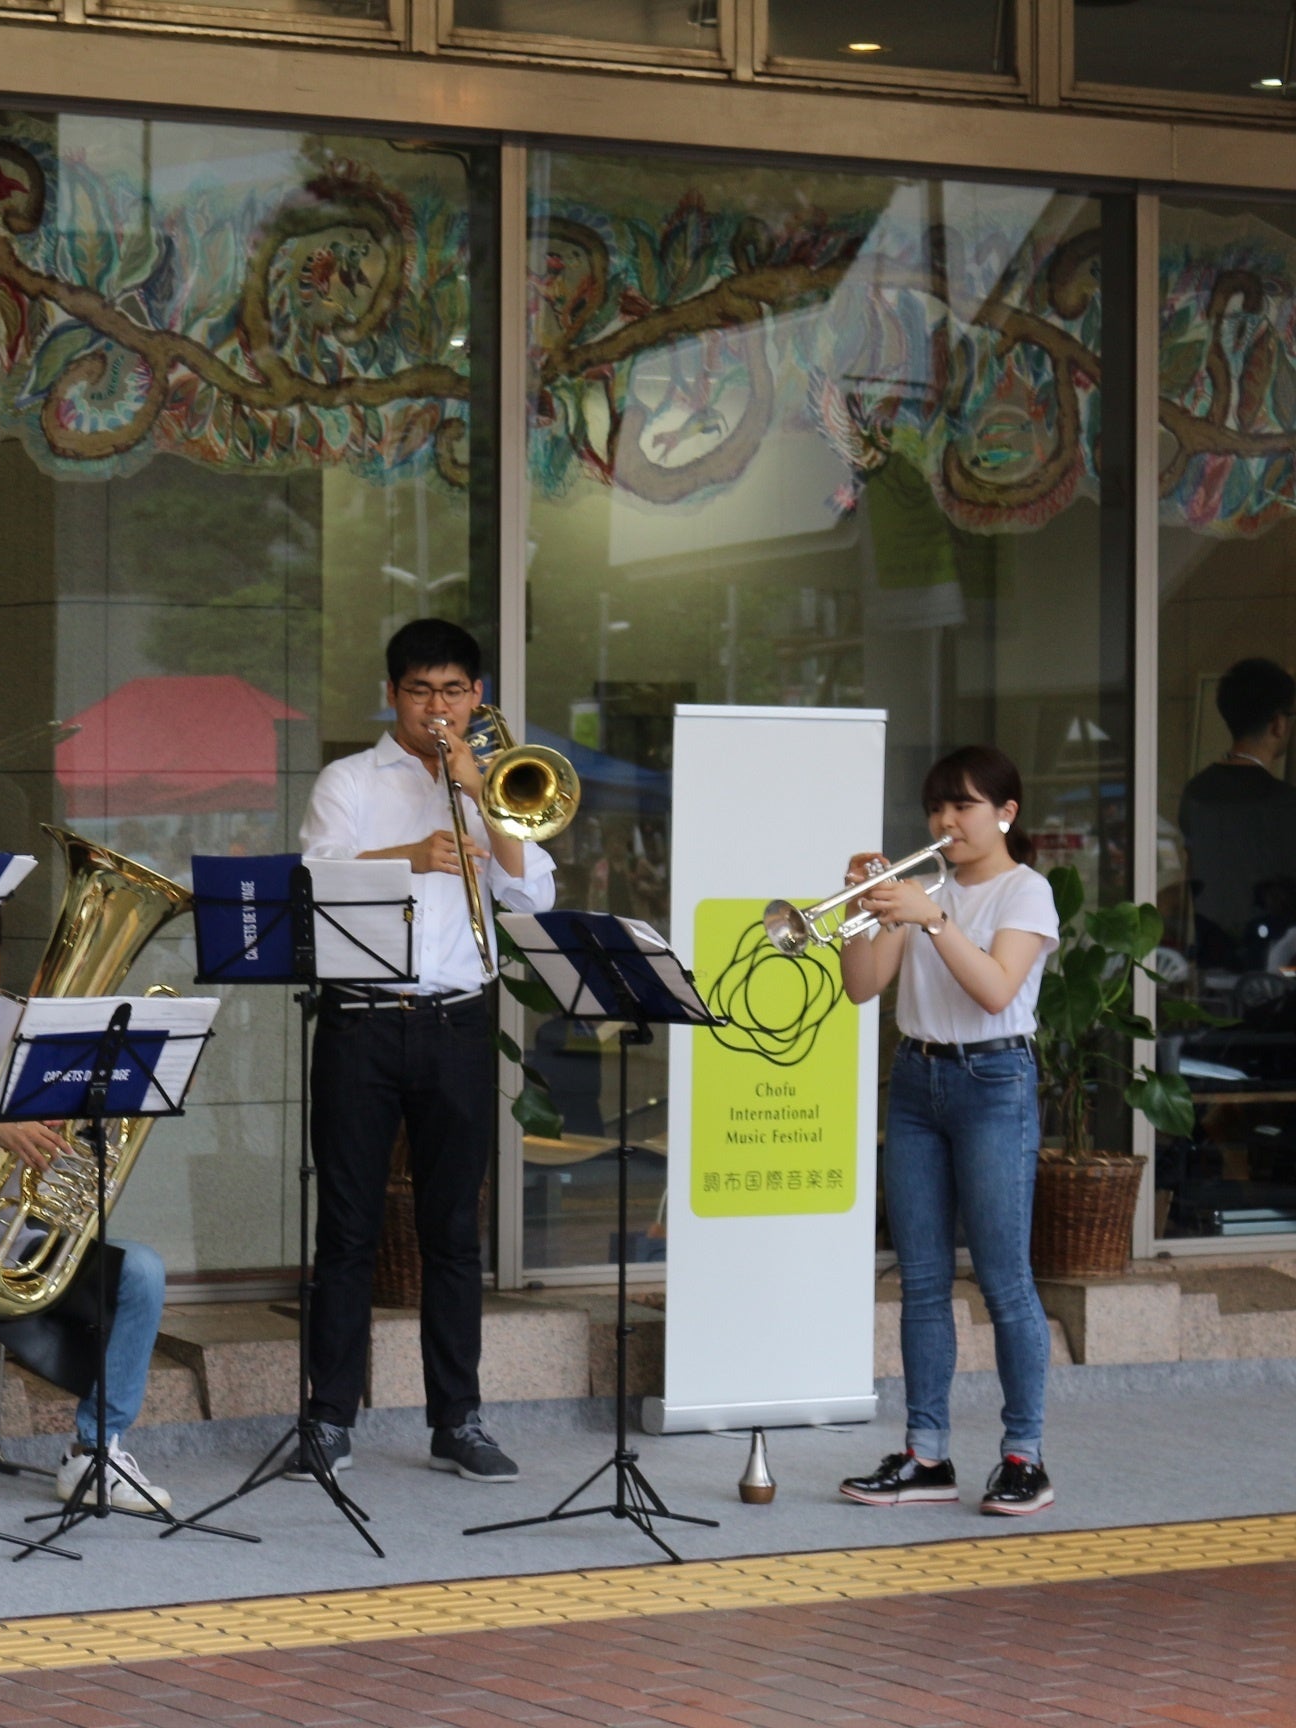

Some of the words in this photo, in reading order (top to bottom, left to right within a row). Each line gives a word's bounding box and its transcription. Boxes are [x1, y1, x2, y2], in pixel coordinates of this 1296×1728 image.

[755, 1081, 797, 1098] Chofu
[730, 1104, 820, 1121] International
[726, 1129, 767, 1144] Music
[772, 1127, 823, 1144] Festival
[703, 1168, 844, 1192] 調布国際音楽祭
